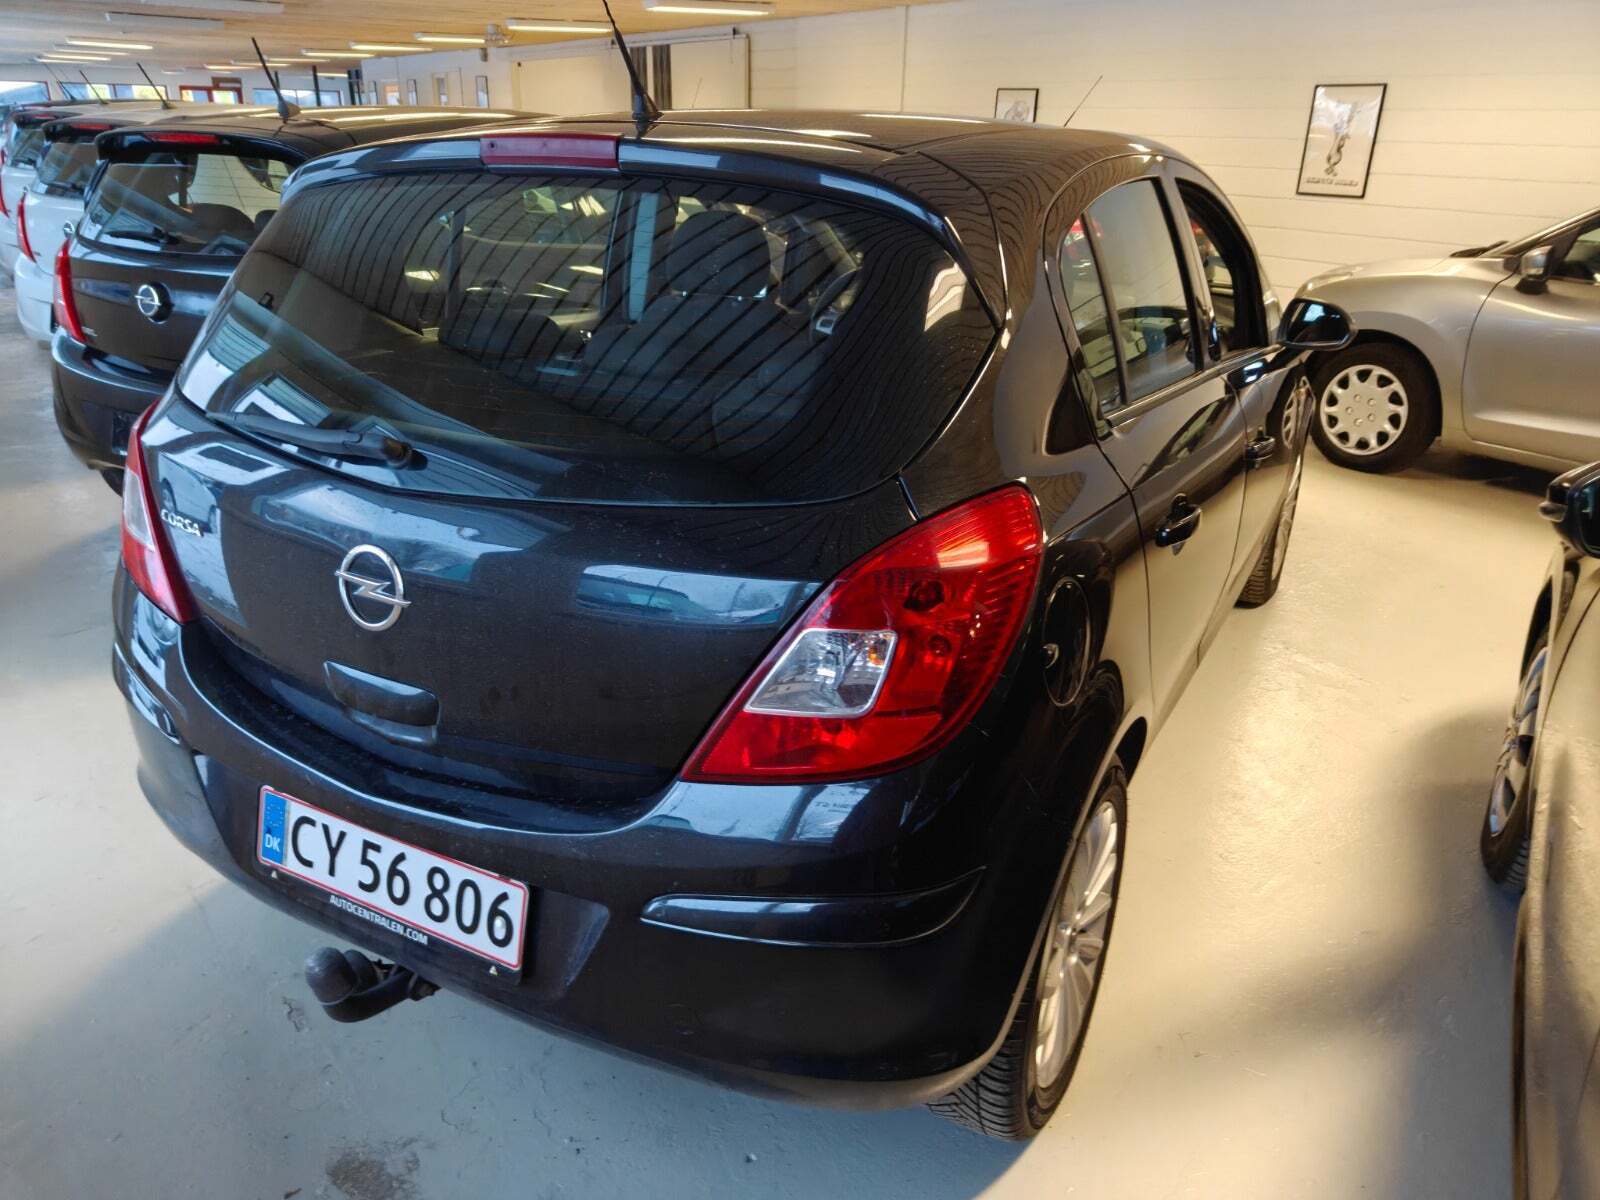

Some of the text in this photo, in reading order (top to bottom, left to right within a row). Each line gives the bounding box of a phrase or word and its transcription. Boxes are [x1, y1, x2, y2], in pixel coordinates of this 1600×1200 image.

[161, 508, 201, 537] CORSA
[265, 833, 281, 852] DK
[291, 815, 514, 948] CY 56 806
[329, 894, 428, 945] AUTOCENTRALEN.COM
